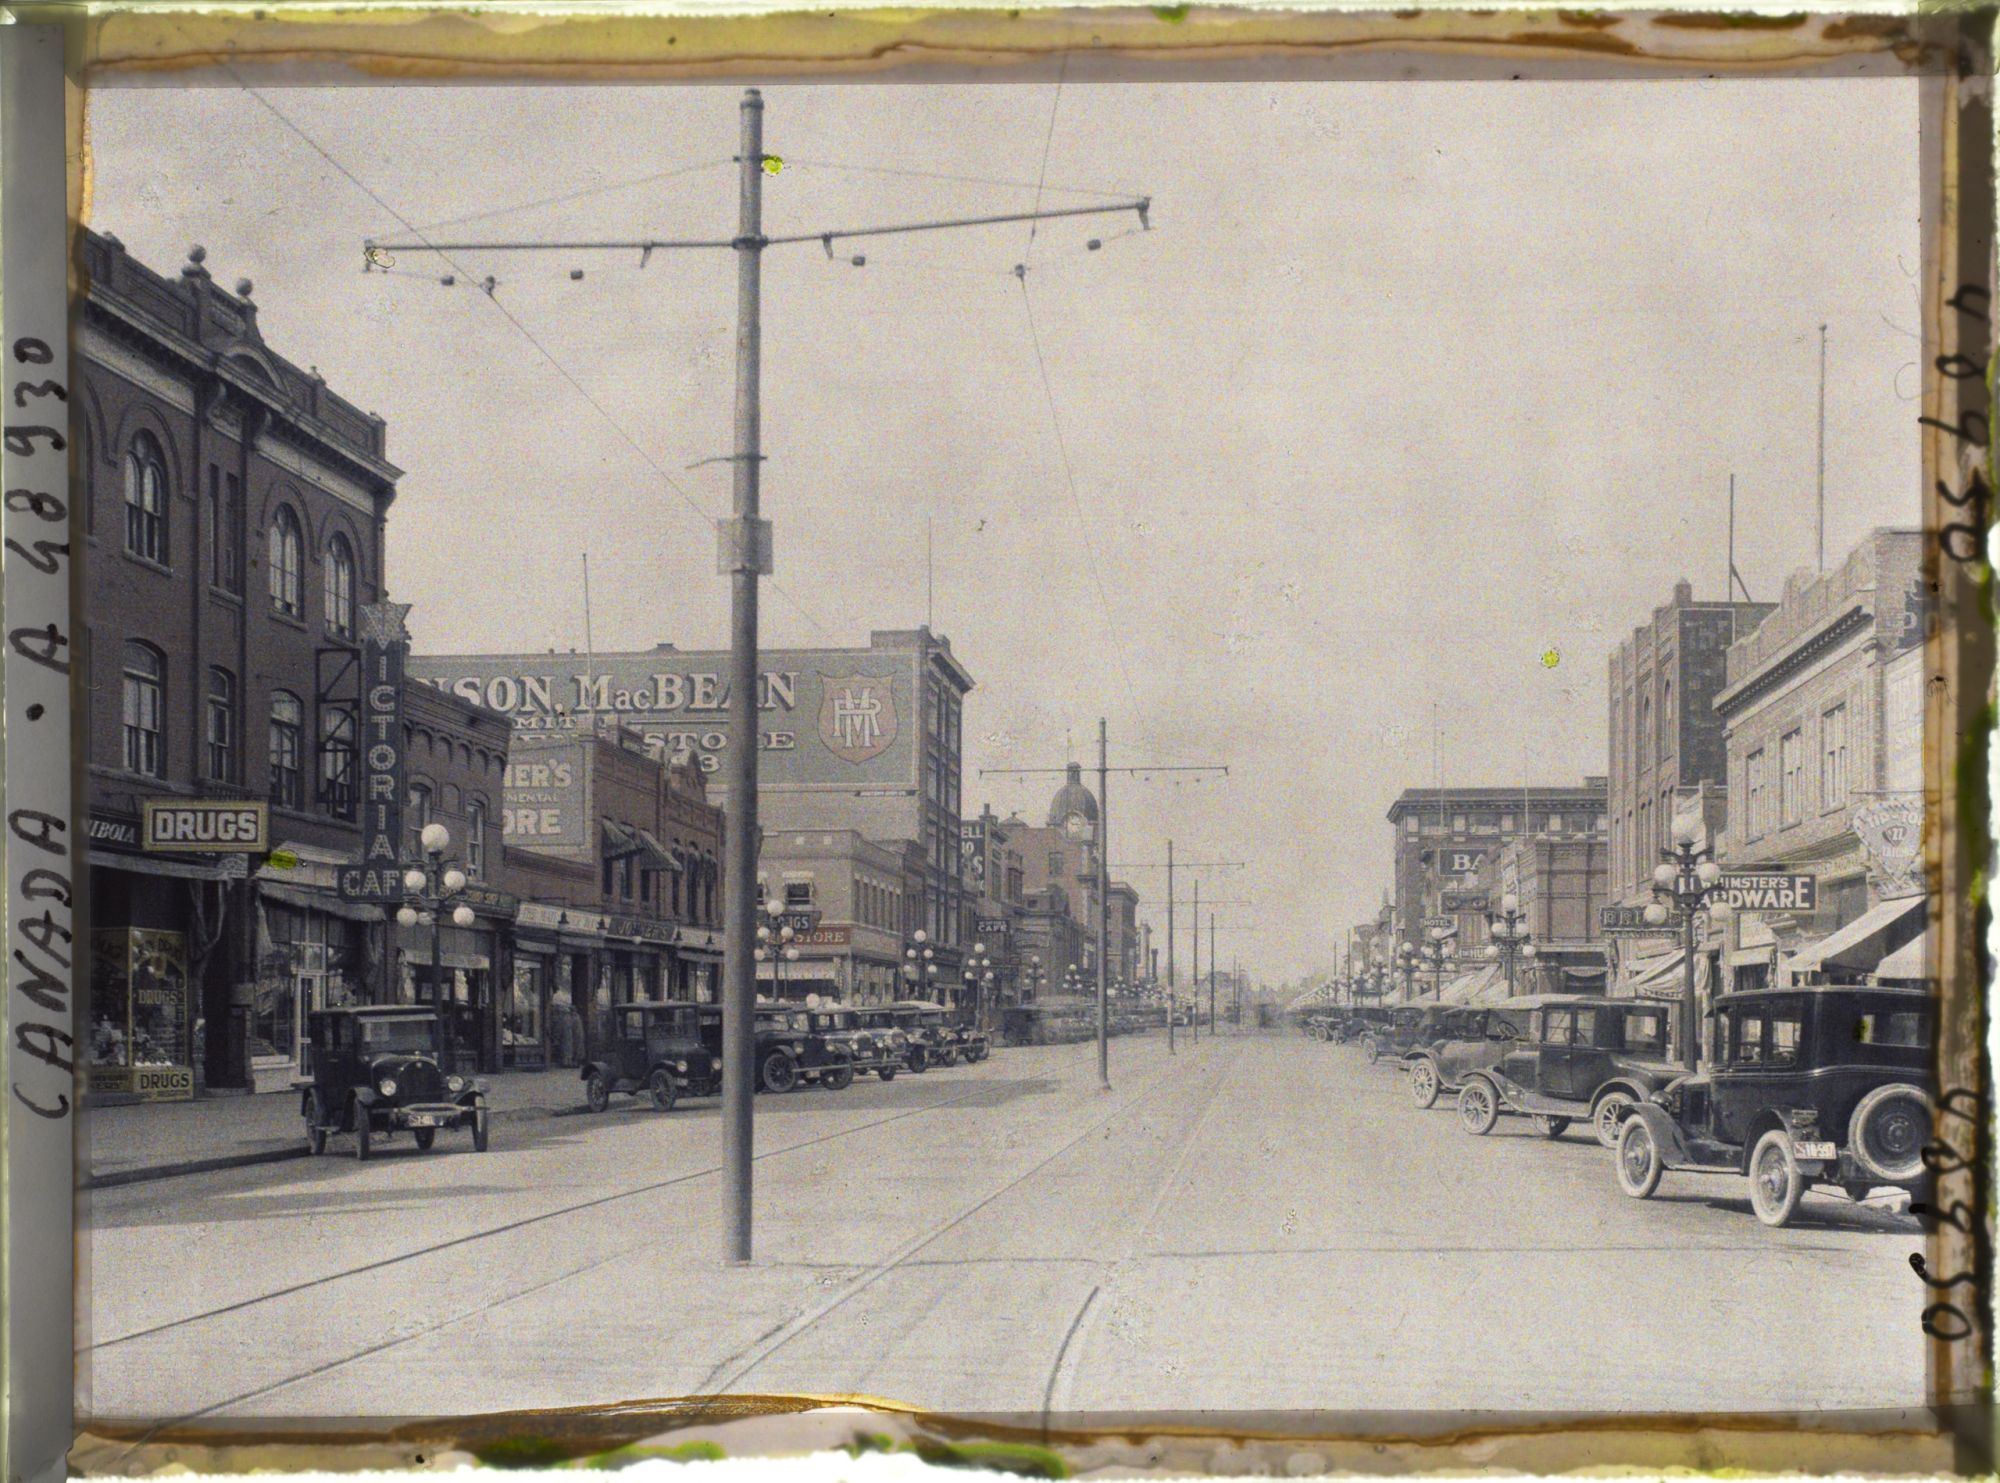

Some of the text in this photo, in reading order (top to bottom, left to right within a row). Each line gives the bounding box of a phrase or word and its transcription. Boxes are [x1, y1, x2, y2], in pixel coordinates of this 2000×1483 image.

[574, 672, 800, 710] MacBEN
[360, 603, 412, 860] VICTORIA
[643, 731, 795, 749] STOE
[154, 811, 257, 841] DRUGS
[342, 870, 400, 896] CAF
[8, 808, 74, 1119] CANADA
[138, 990, 178, 1005] DRUGS
[140, 1073, 190, 1089] DRUGS
